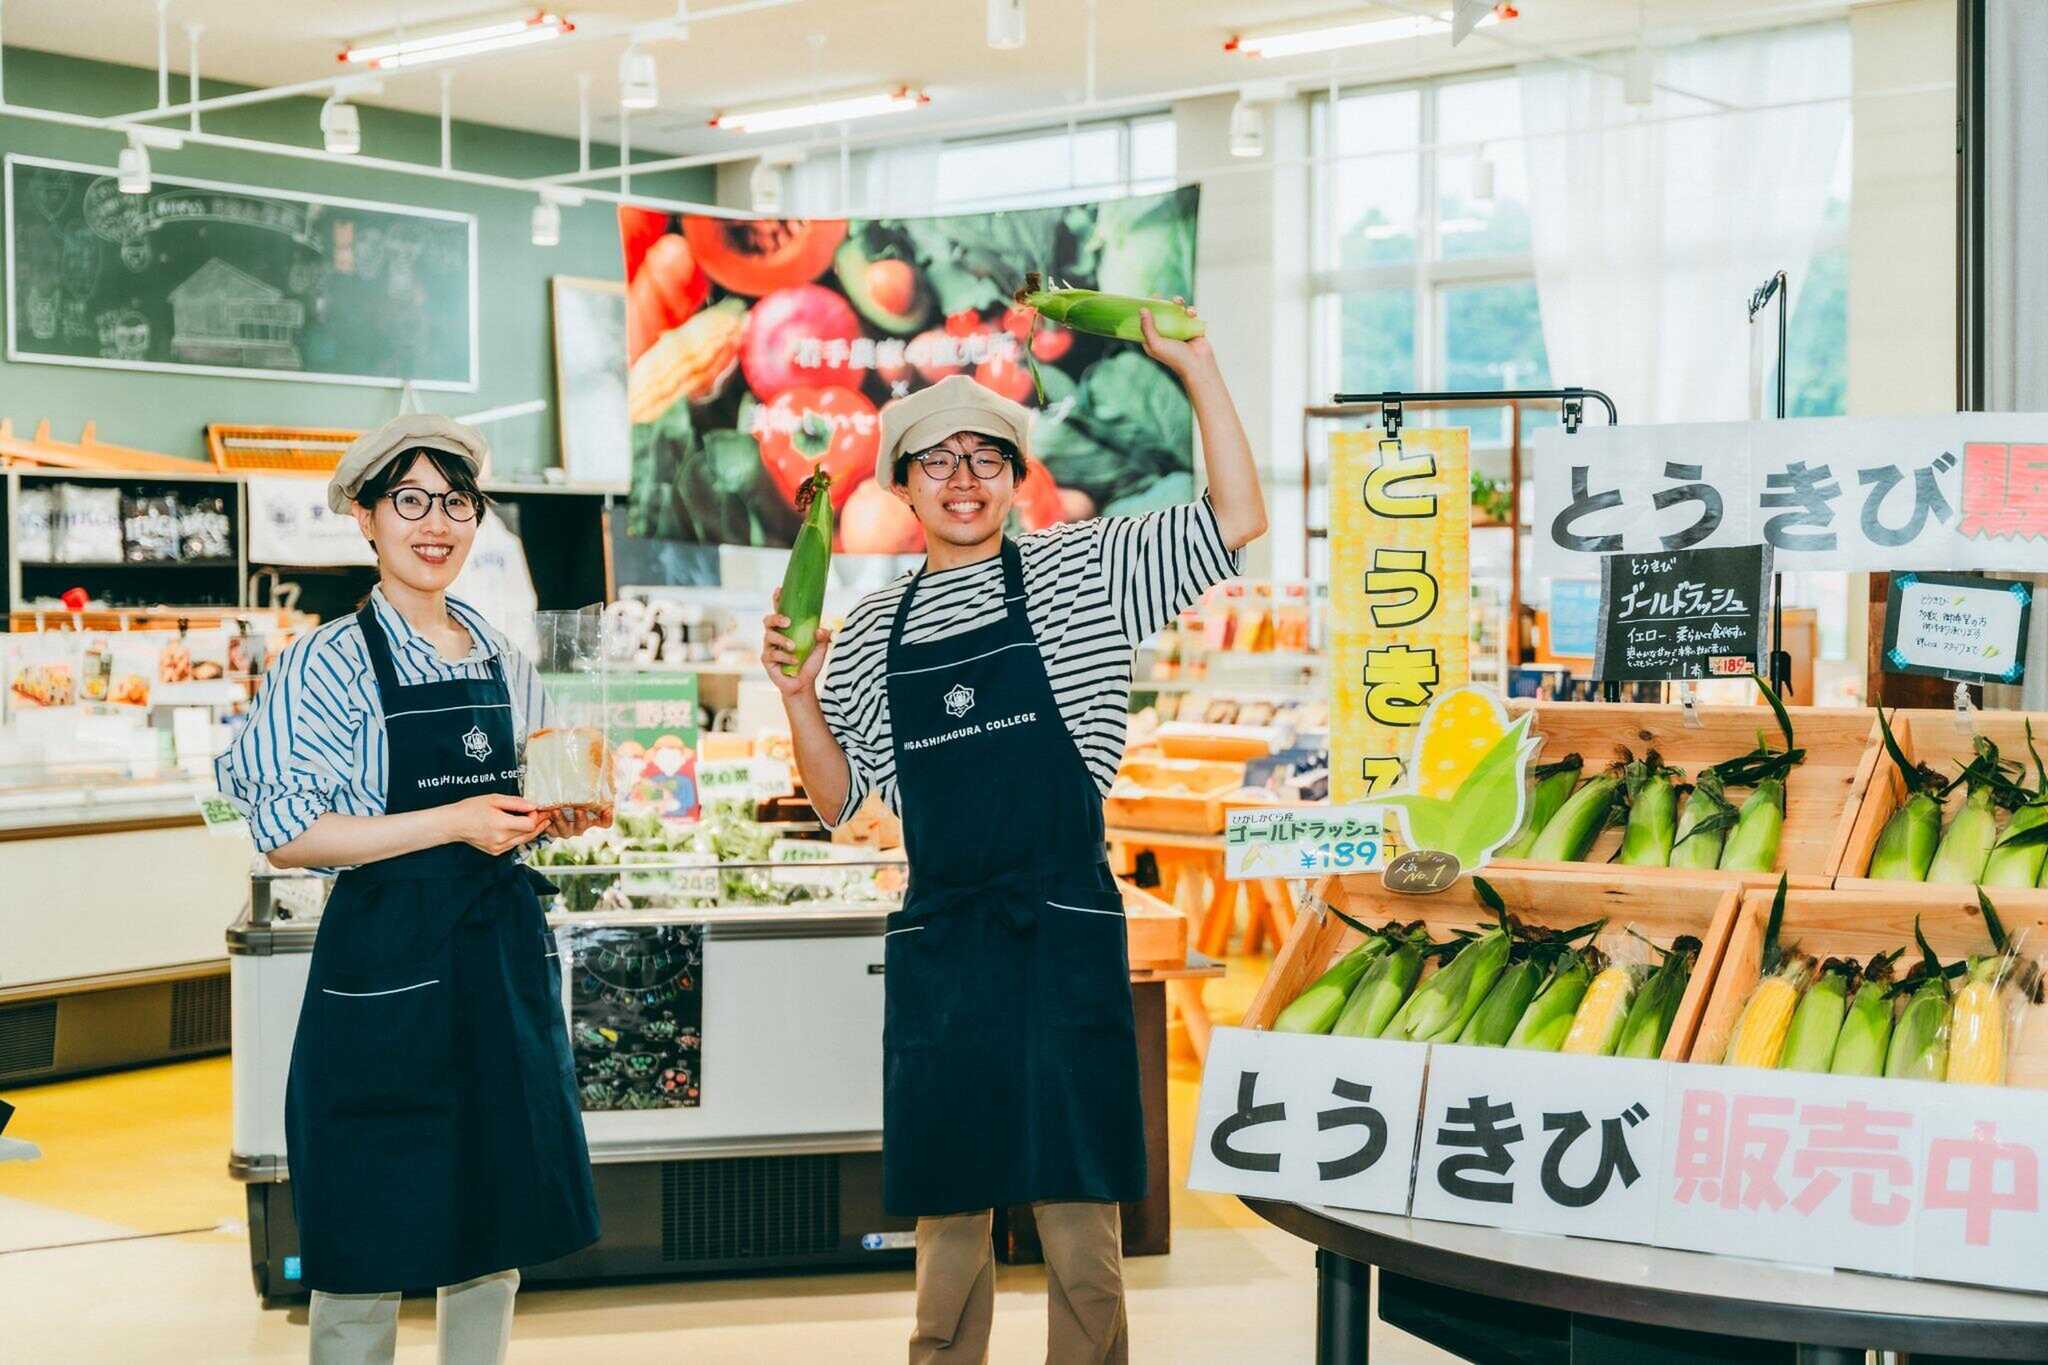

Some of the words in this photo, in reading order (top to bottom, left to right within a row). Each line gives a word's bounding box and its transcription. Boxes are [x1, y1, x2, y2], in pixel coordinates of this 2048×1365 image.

[1631, 557, 1677, 576] とうきび
[1618, 581, 1749, 619] ゴールドラッシュ
[904, 725, 982, 750] HIGASHIKAGURA
[985, 712, 1037, 731] COLLEGE
[1229, 820, 1379, 843] ゴールドラッシュ
[1300, 840, 1378, 869] ¥189
[1394, 857, 1418, 874] 人気
